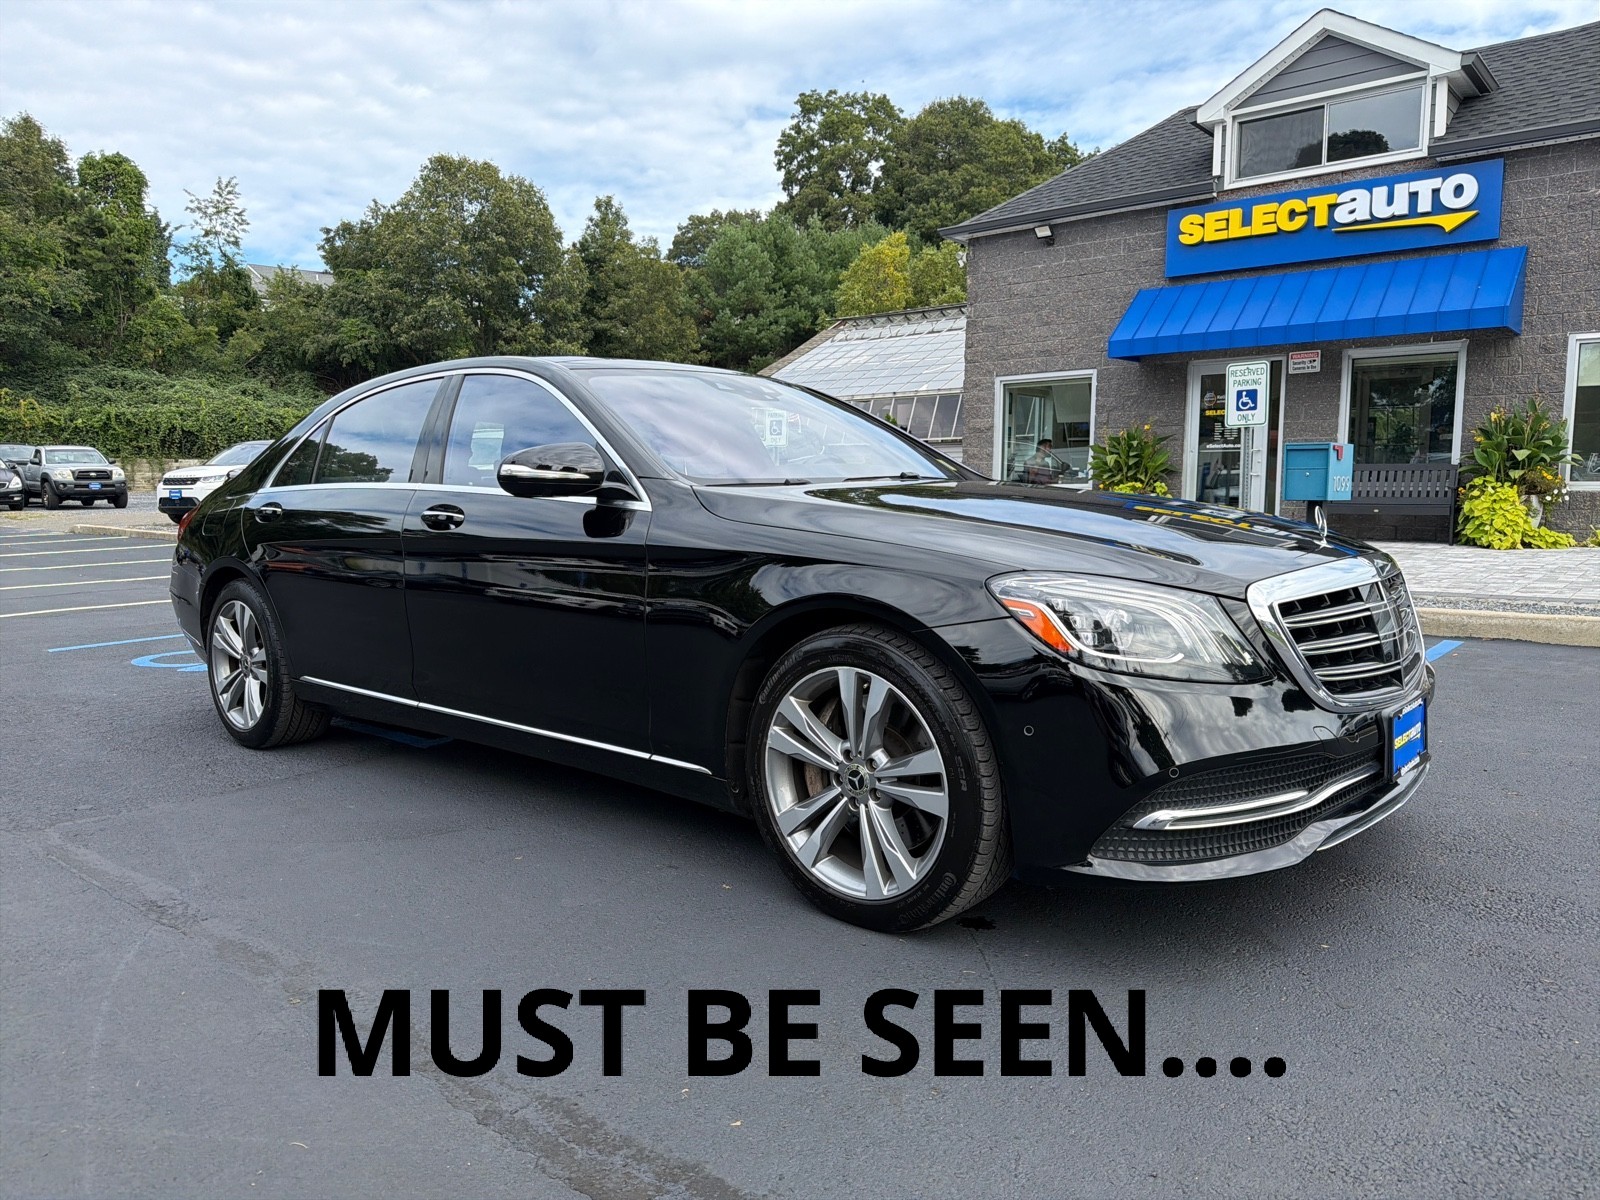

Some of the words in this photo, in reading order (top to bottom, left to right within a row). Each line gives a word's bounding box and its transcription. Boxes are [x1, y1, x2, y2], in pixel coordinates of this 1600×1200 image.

[1230, 367, 1265, 377] RESERVED
[1232, 378, 1262, 387] PARKING
[1237, 413, 1255, 422] ONLY
[1333, 475, 1350, 492] 1099
